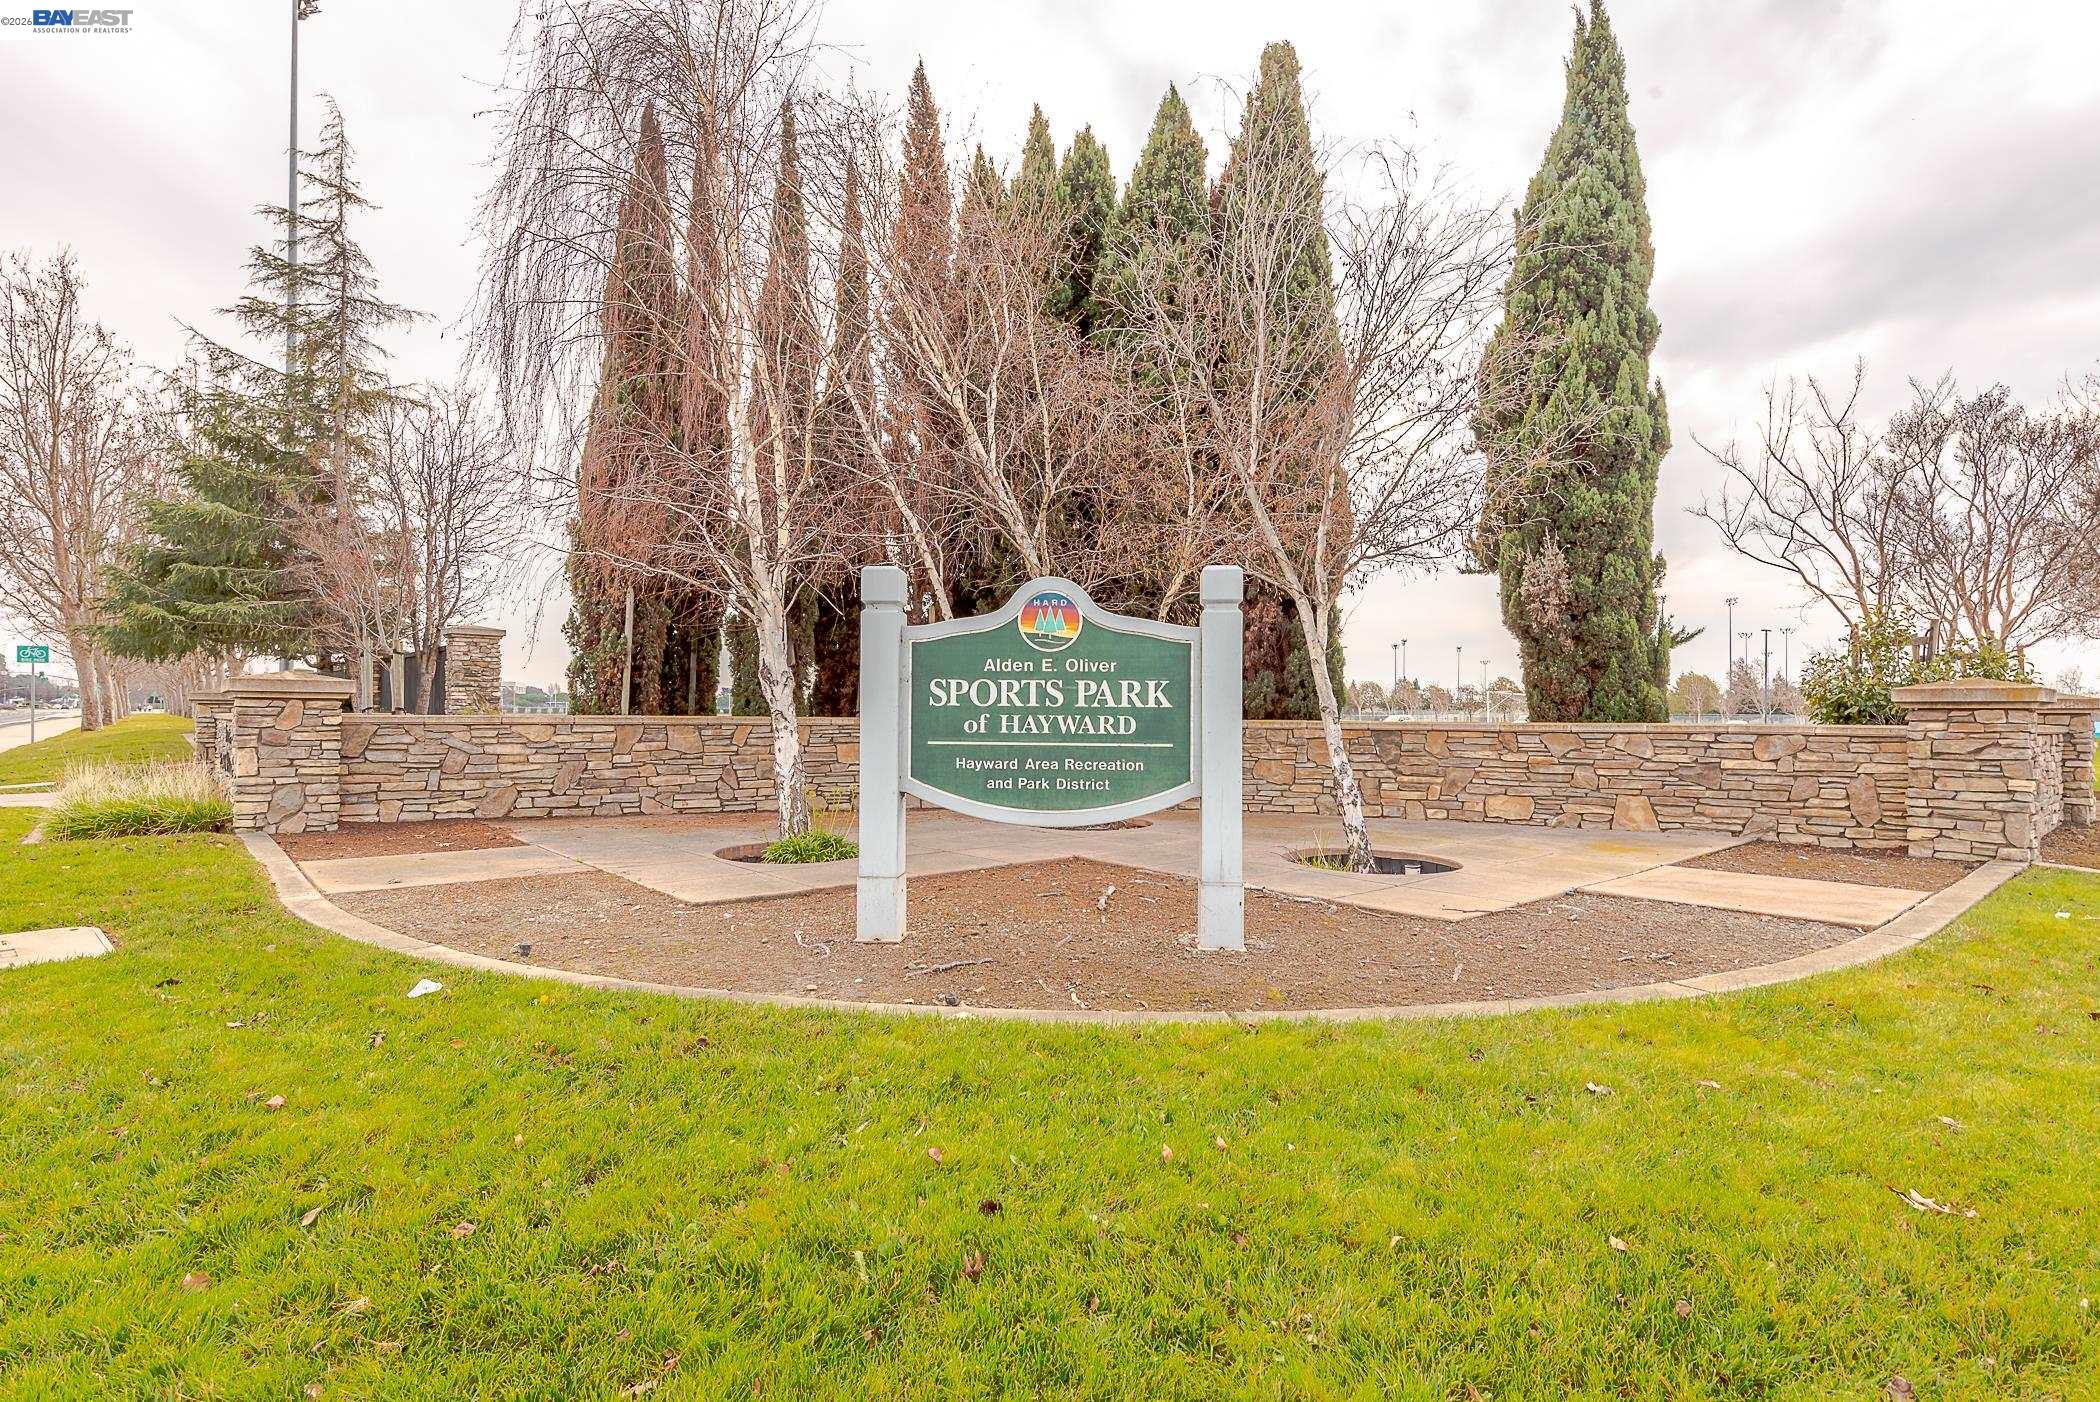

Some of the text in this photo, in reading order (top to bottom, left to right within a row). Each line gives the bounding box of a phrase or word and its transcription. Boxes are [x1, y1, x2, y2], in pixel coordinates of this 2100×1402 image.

[1033, 597, 1068, 607] HARD
[984, 658, 1117, 673] Alden E. Oliver
[928, 678, 1173, 708] SPORTS PARK
[963, 713, 1137, 735] of HAYWARD
[955, 757, 1144, 772] Hayward Area Recreation
[986, 777, 1110, 791] and Park District
